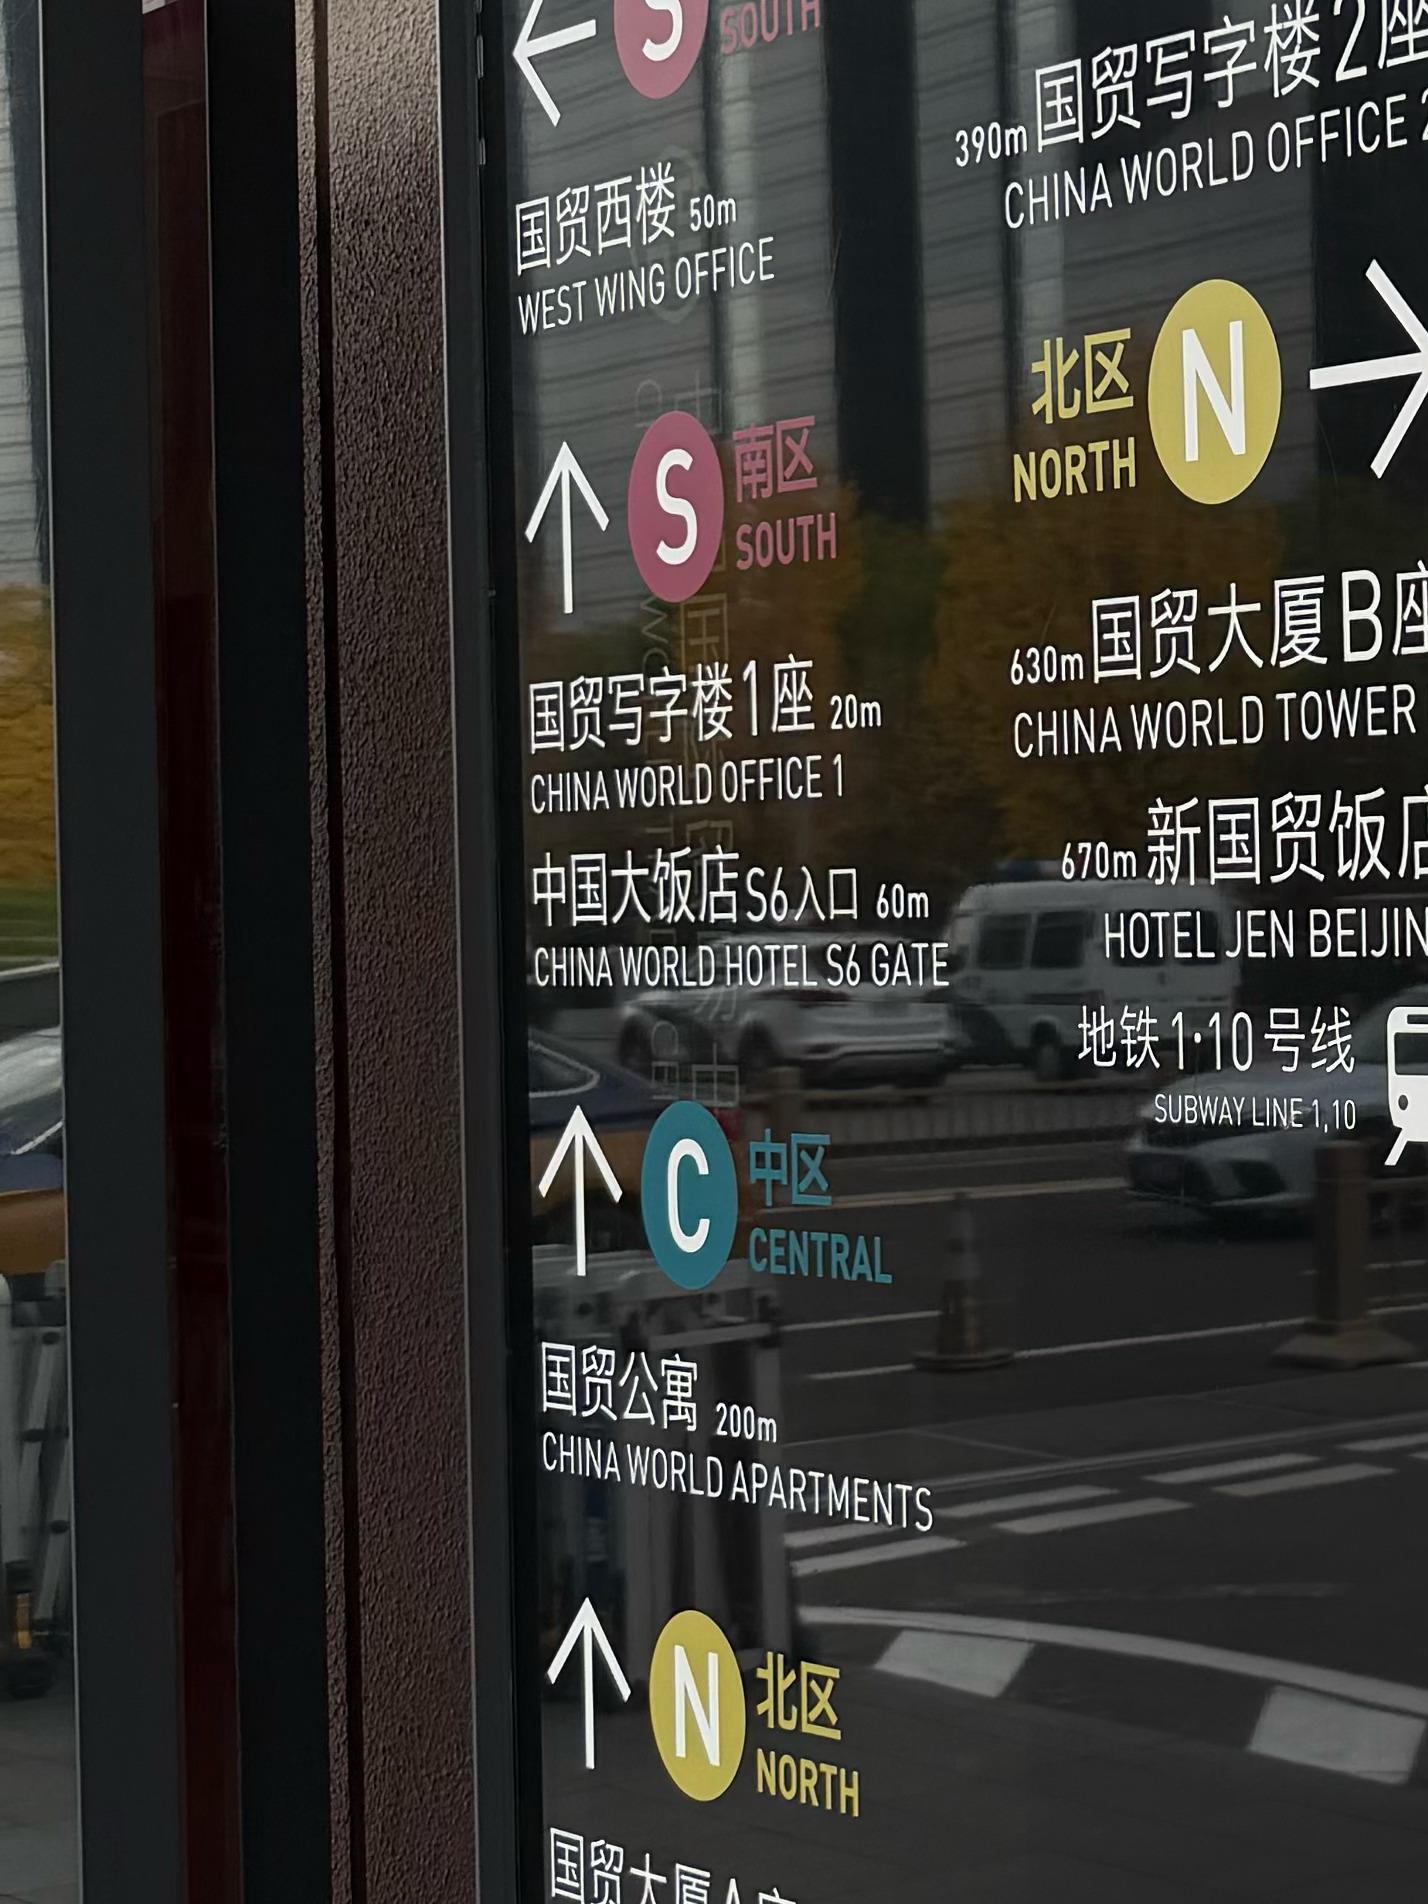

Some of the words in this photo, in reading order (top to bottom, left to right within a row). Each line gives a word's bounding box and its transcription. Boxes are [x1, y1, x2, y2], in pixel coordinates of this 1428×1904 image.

[955, 121, 1028, 168] 390m
[1005, 162, 1113, 229] CHINA
[1120, 130, 1254, 204] WORLD
[1267, 93, 1408, 173] OFFICE
[515, 161, 676, 276] 国贸西楼
[689, 193, 737, 232] 50m
[517, 280, 587, 335] WEST
[594, 262, 665, 317] WING
[675, 236, 775, 299] OFFICE
[1030, 327, 1134, 425] 北区
[1181, 319, 1247, 463] N
[732, 415, 818, 503] 南区
[1013, 436, 1137, 503] NORTH
[655, 448, 698, 566] S
[736, 512, 837, 570] SOUTH
[1010, 645, 1084, 686] 630m
[830, 693, 882, 730] 20m
[1014, 706, 1122, 758] CHINA
[1130, 695, 1264, 751] WORLD
[1275, 683, 1416, 742] TOWER
[531, 770, 610, 814] CHINA
[614, 762, 712, 809] WORLD
[721, 754, 823, 803] OFFICE
[833, 753, 843, 797] 1
[1061, 841, 1137, 880] 670m
[876, 883, 929, 919] 60m
[1104, 910, 1216, 959] HOTEL
[1225, 909, 1294, 959] JEN
[534, 946, 613, 987] CHINA
[619, 945, 715, 987] WORLD
[725, 944, 818, 987] HOTEL
[826, 943, 861, 987] S6
[871, 942, 950, 987] GATE
[1154, 1093, 1246, 1126] SUBWAY
[1252, 1096, 1304, 1128] LINE
[667, 1138, 710, 1253] C
[748, 1127, 833, 1208] 中区
[747, 1226, 893, 1285] CENTRAL
[541, 1341, 698, 1432] 国贸公寓
[715, 1402, 777, 1444] 200m
[542, 1431, 621, 1482] CHINA
[626, 1443, 723, 1498] WORLD
[731, 1460, 933, 1532] APARTMENTS
[673, 1644, 721, 1767] N
[756, 1651, 842, 1741] 北区
[756, 1748, 861, 1818] NORTH
